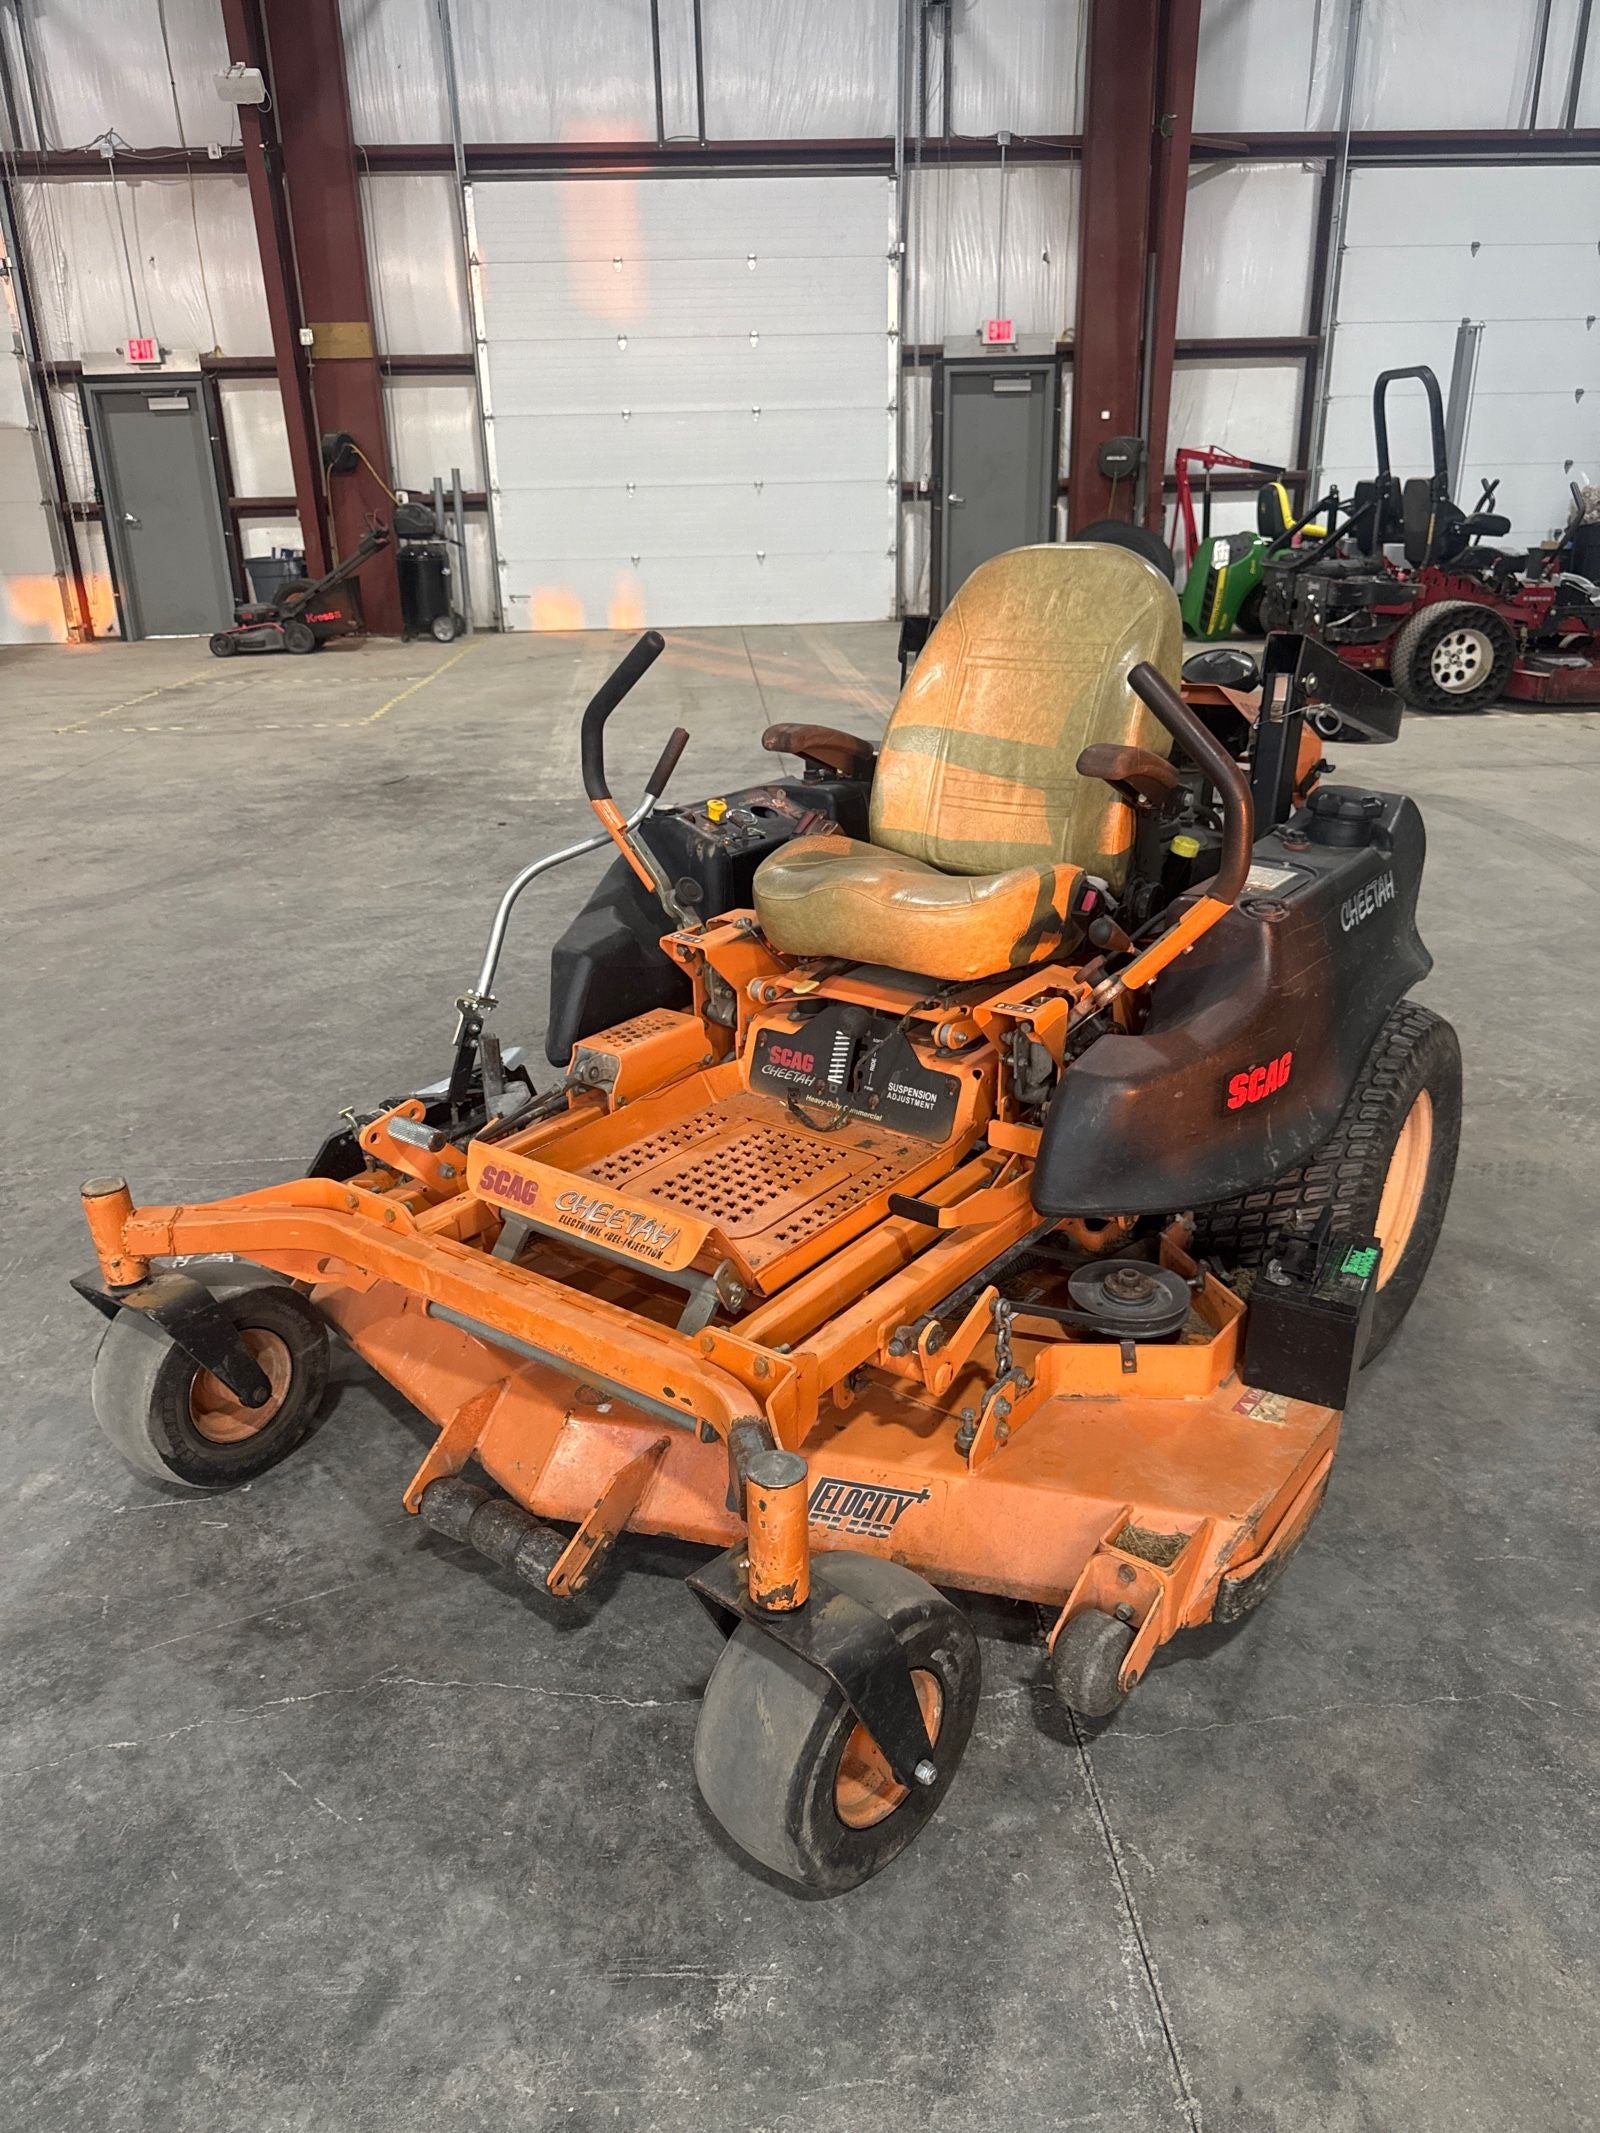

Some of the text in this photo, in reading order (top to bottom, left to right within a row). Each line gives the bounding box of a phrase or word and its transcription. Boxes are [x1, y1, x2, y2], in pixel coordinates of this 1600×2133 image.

[989, 320, 1012, 341] EXIT
[128, 339, 154, 361] EXIT
[1340, 870, 1395, 932] CHEETAH
[769, 1045, 815, 1073] SCAG
[869, 1057, 877, 1071] RIDE
[761, 1064, 817, 1087] CHEETAH
[1227, 1051, 1293, 1110] SCAG
[886, 1092, 936, 1111] ADJUSTMENT
[888, 1082, 938, 1103] SUSPENSION
[805, 1094, 882, 1121] Heavy-Duty Cmmercial
[479, 1165, 539, 1206] SCAG
[555, 1190, 680, 1249] CHEETAH
[558, 1214, 603, 1238] ELECTRONIC
